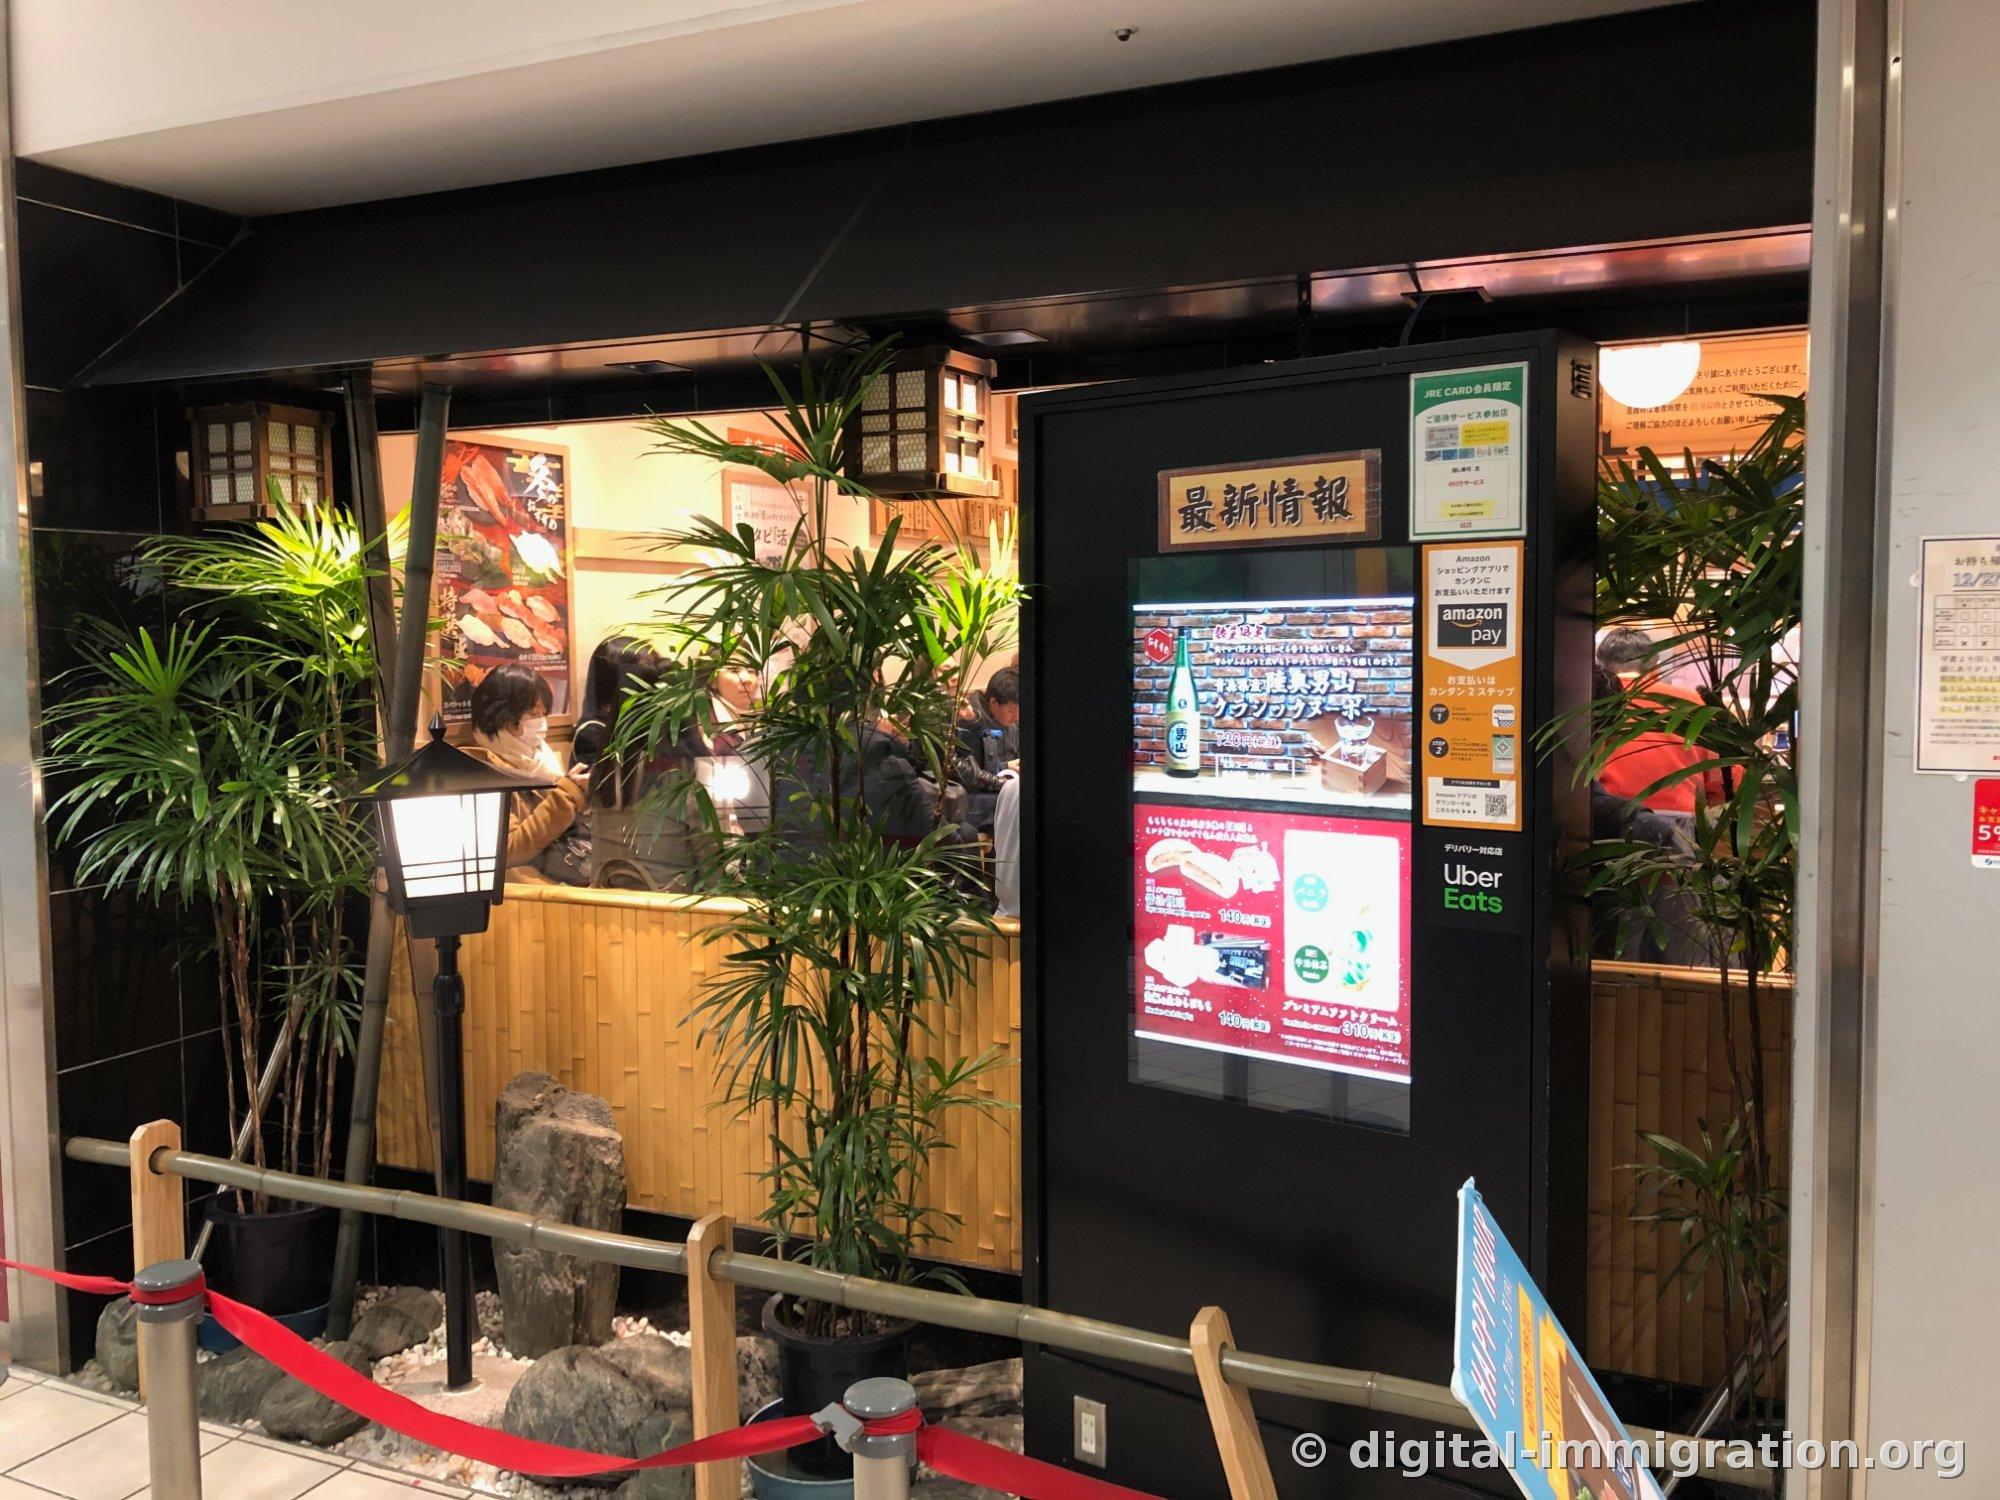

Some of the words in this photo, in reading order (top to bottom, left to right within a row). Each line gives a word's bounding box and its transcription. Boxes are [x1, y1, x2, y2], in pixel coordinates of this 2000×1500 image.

[1424, 389, 1442, 398] JRE
[1177, 475, 1355, 534] 最新情報
[1437, 565, 1510, 575] ショッピングアプリで
[1455, 577, 1491, 585] カンタンに
[1435, 587, 1511, 597] お支払いいただけます
[1442, 607, 1503, 621] amazon
[1471, 628, 1502, 645] pay
[1446, 676, 1496, 686] お支払いは
[1213, 697, 1378, 721] クラシックヌーボー
[1444, 863, 1503, 888] Uber
[1444, 887, 1503, 914] Eats
[1473, 1203, 1496, 1304] HOUR
[1471, 1277, 1497, 1420] HAPPY
